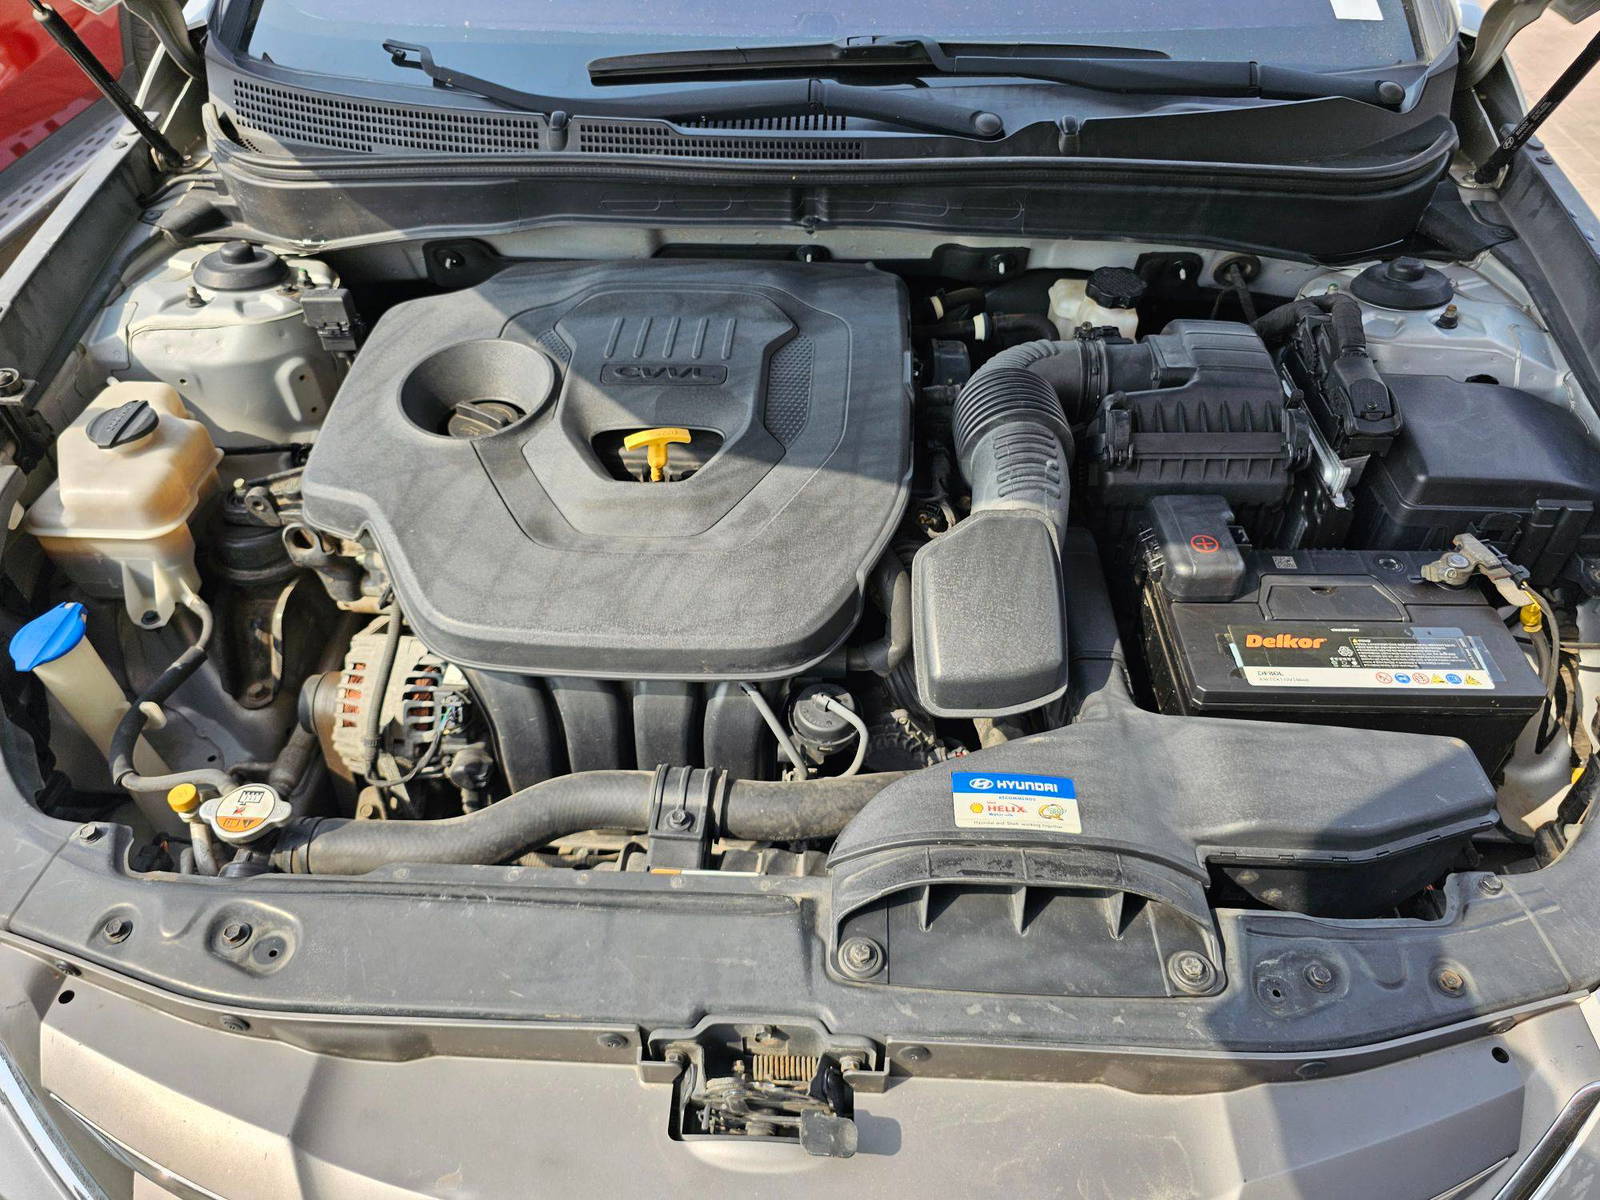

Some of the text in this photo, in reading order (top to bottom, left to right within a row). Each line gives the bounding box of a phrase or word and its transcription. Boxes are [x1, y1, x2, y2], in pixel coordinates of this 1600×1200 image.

[1245, 634, 1326, 649] Delkor
[997, 780, 1058, 792] HYUNDAI
[987, 804, 1025, 813] HELIX
